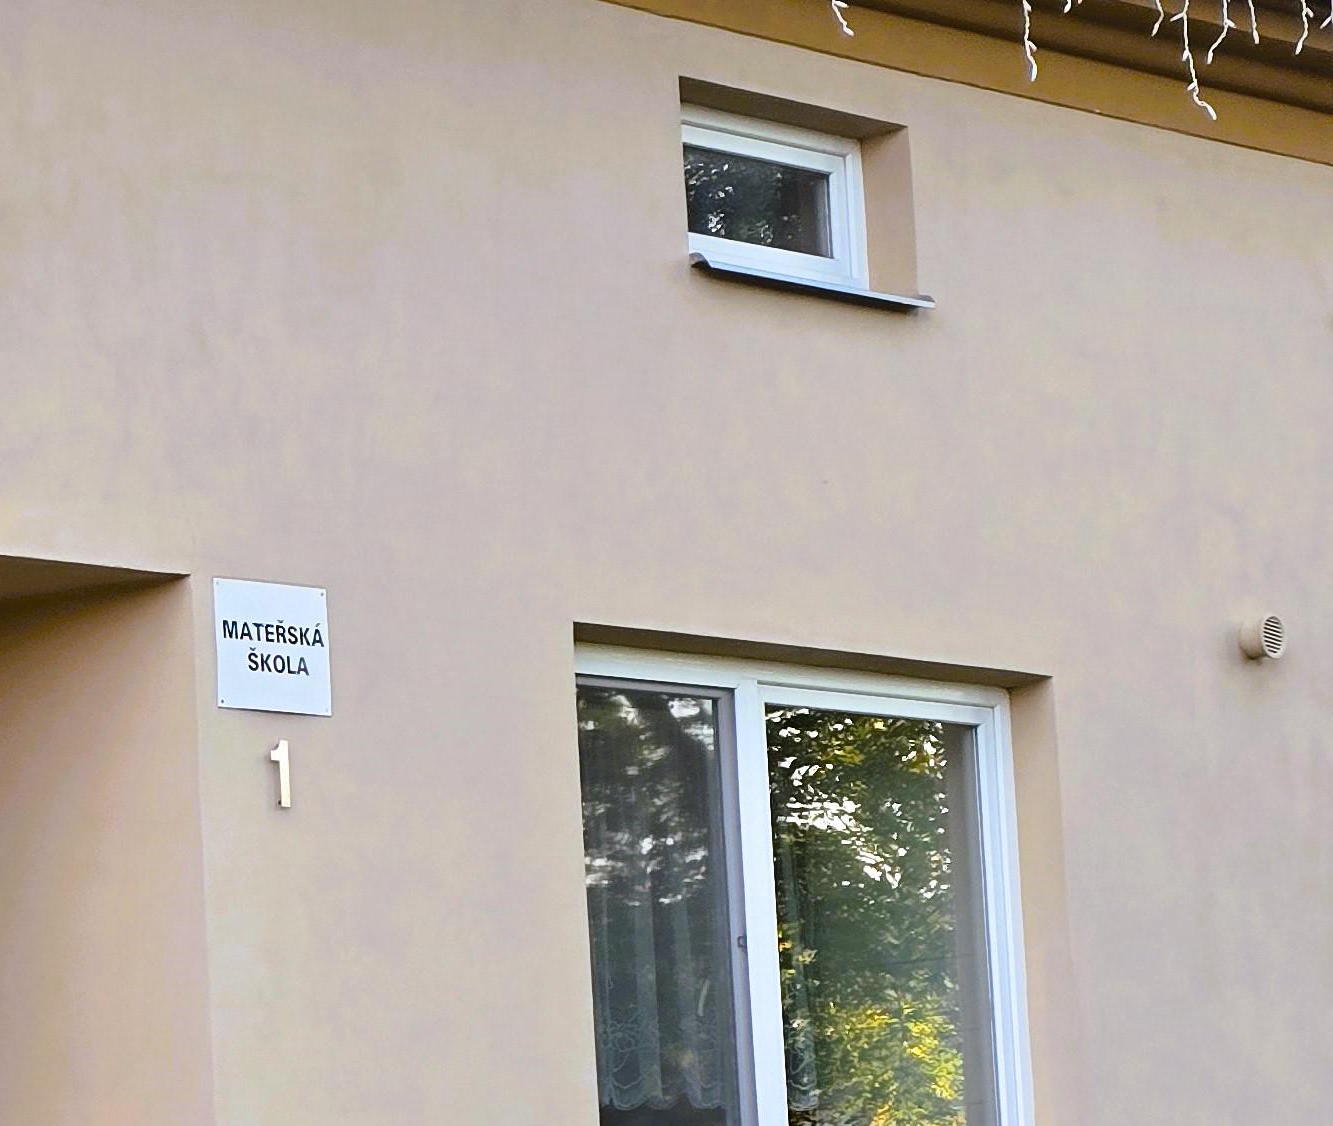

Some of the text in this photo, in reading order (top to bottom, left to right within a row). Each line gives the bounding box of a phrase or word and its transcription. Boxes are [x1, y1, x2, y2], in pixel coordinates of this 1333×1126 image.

[222, 619, 325, 648] MATEŘSKÁ
[247, 647, 310, 676] ŠKOLA
[270, 739, 292, 808] 1
